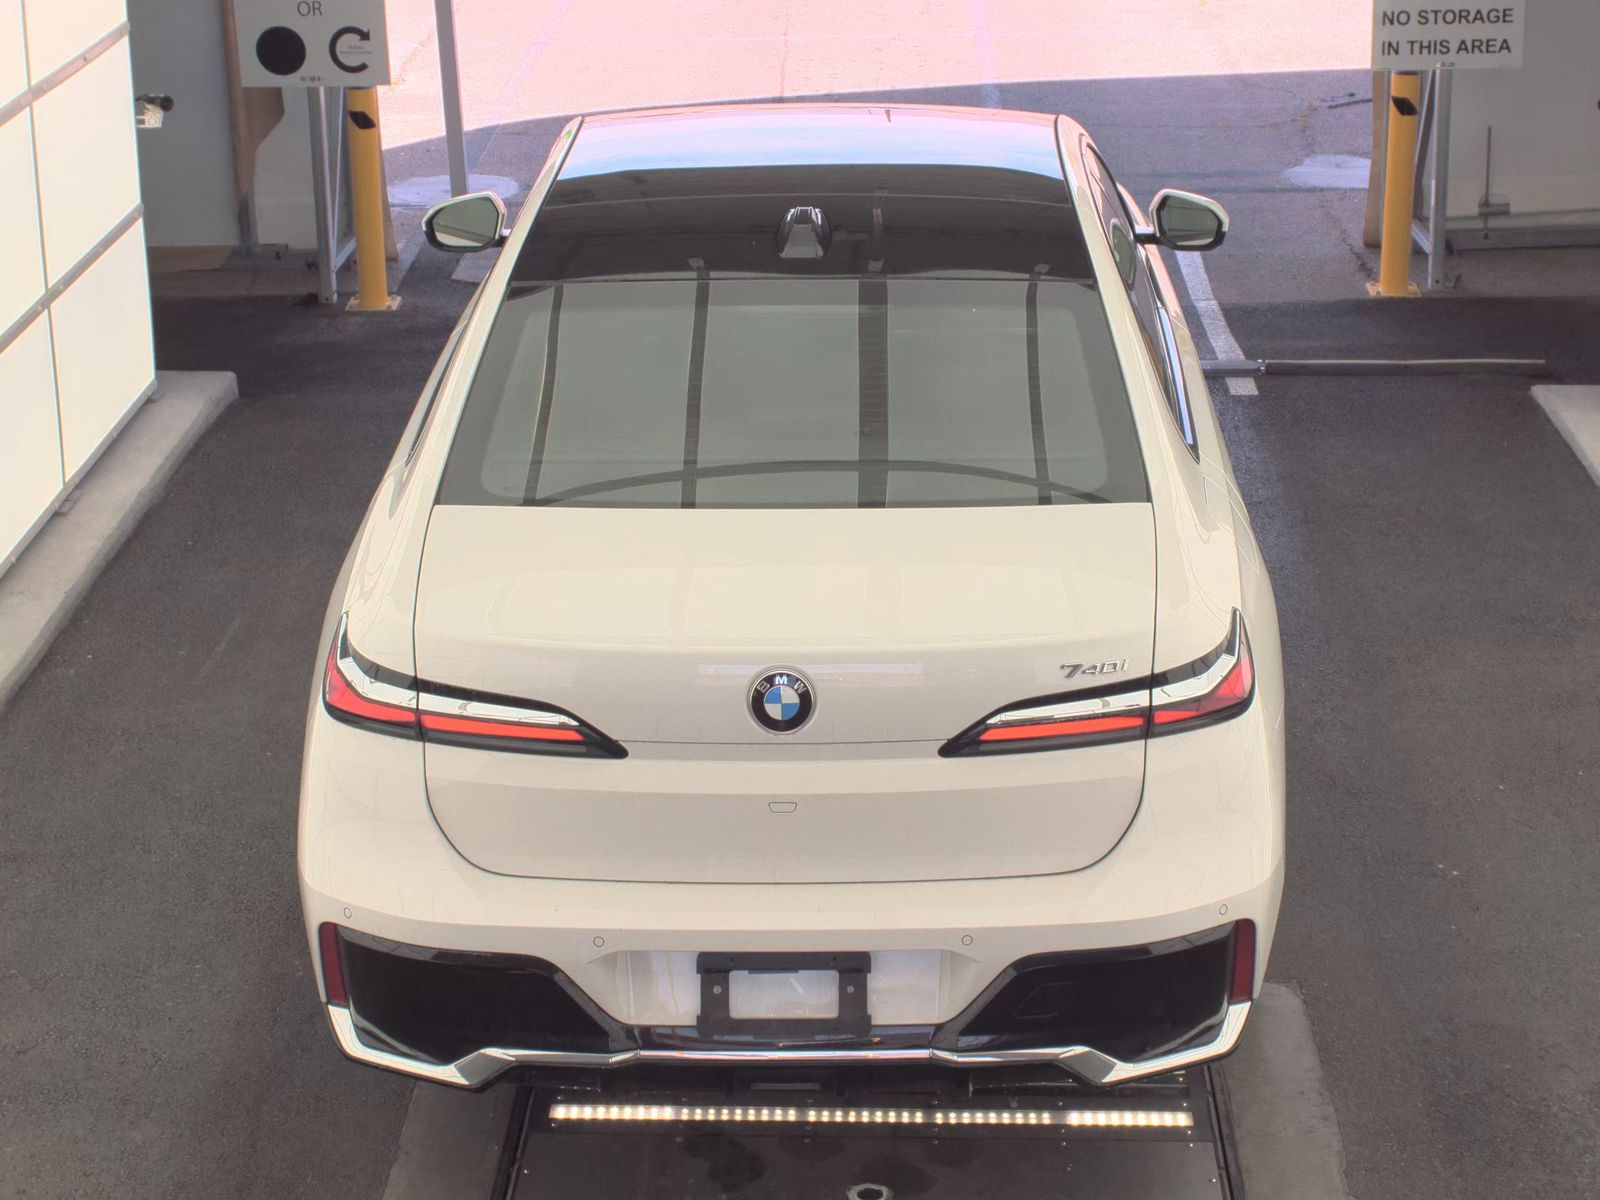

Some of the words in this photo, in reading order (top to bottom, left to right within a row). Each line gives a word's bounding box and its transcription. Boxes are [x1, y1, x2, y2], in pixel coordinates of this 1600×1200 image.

[297, 1, 323, 17] OR
[1382, 10, 1410, 26] NO
[1417, 8, 1514, 25] STORAGE
[1381, 40, 1400, 56] IN
[1407, 39, 1451, 55] THIS
[1456, 38, 1512, 55] AREA
[1059, 658, 1130, 679] 740i
[756, 674, 807, 694] BMW
